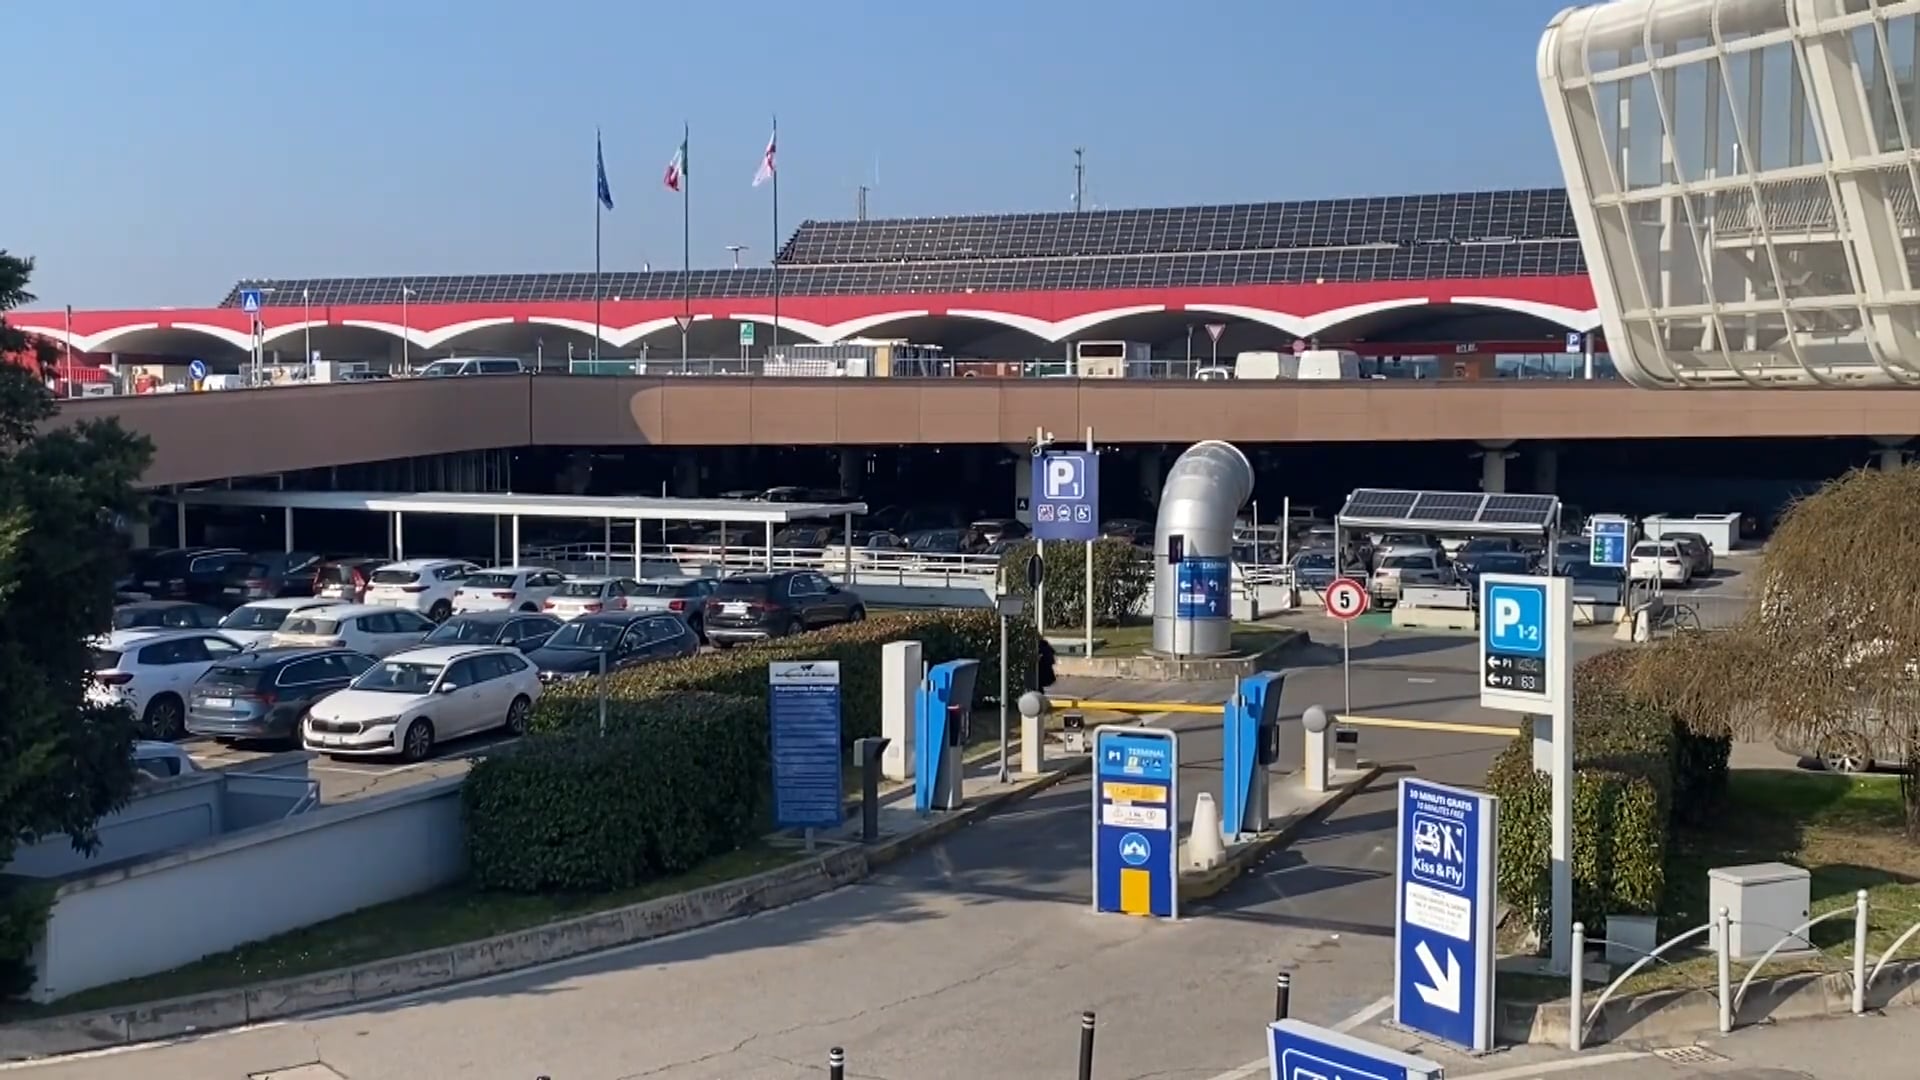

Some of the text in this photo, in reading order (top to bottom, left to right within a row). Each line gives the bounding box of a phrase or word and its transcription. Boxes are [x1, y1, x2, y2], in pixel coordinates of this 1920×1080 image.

[1570, 335, 1578, 344] P
[1340, 590, 1350, 609] 5
[1502, 675, 1513, 686] P2
[1108, 750, 1121, 761] P1
[1414, 857, 1462, 885] Kiss & Fly
